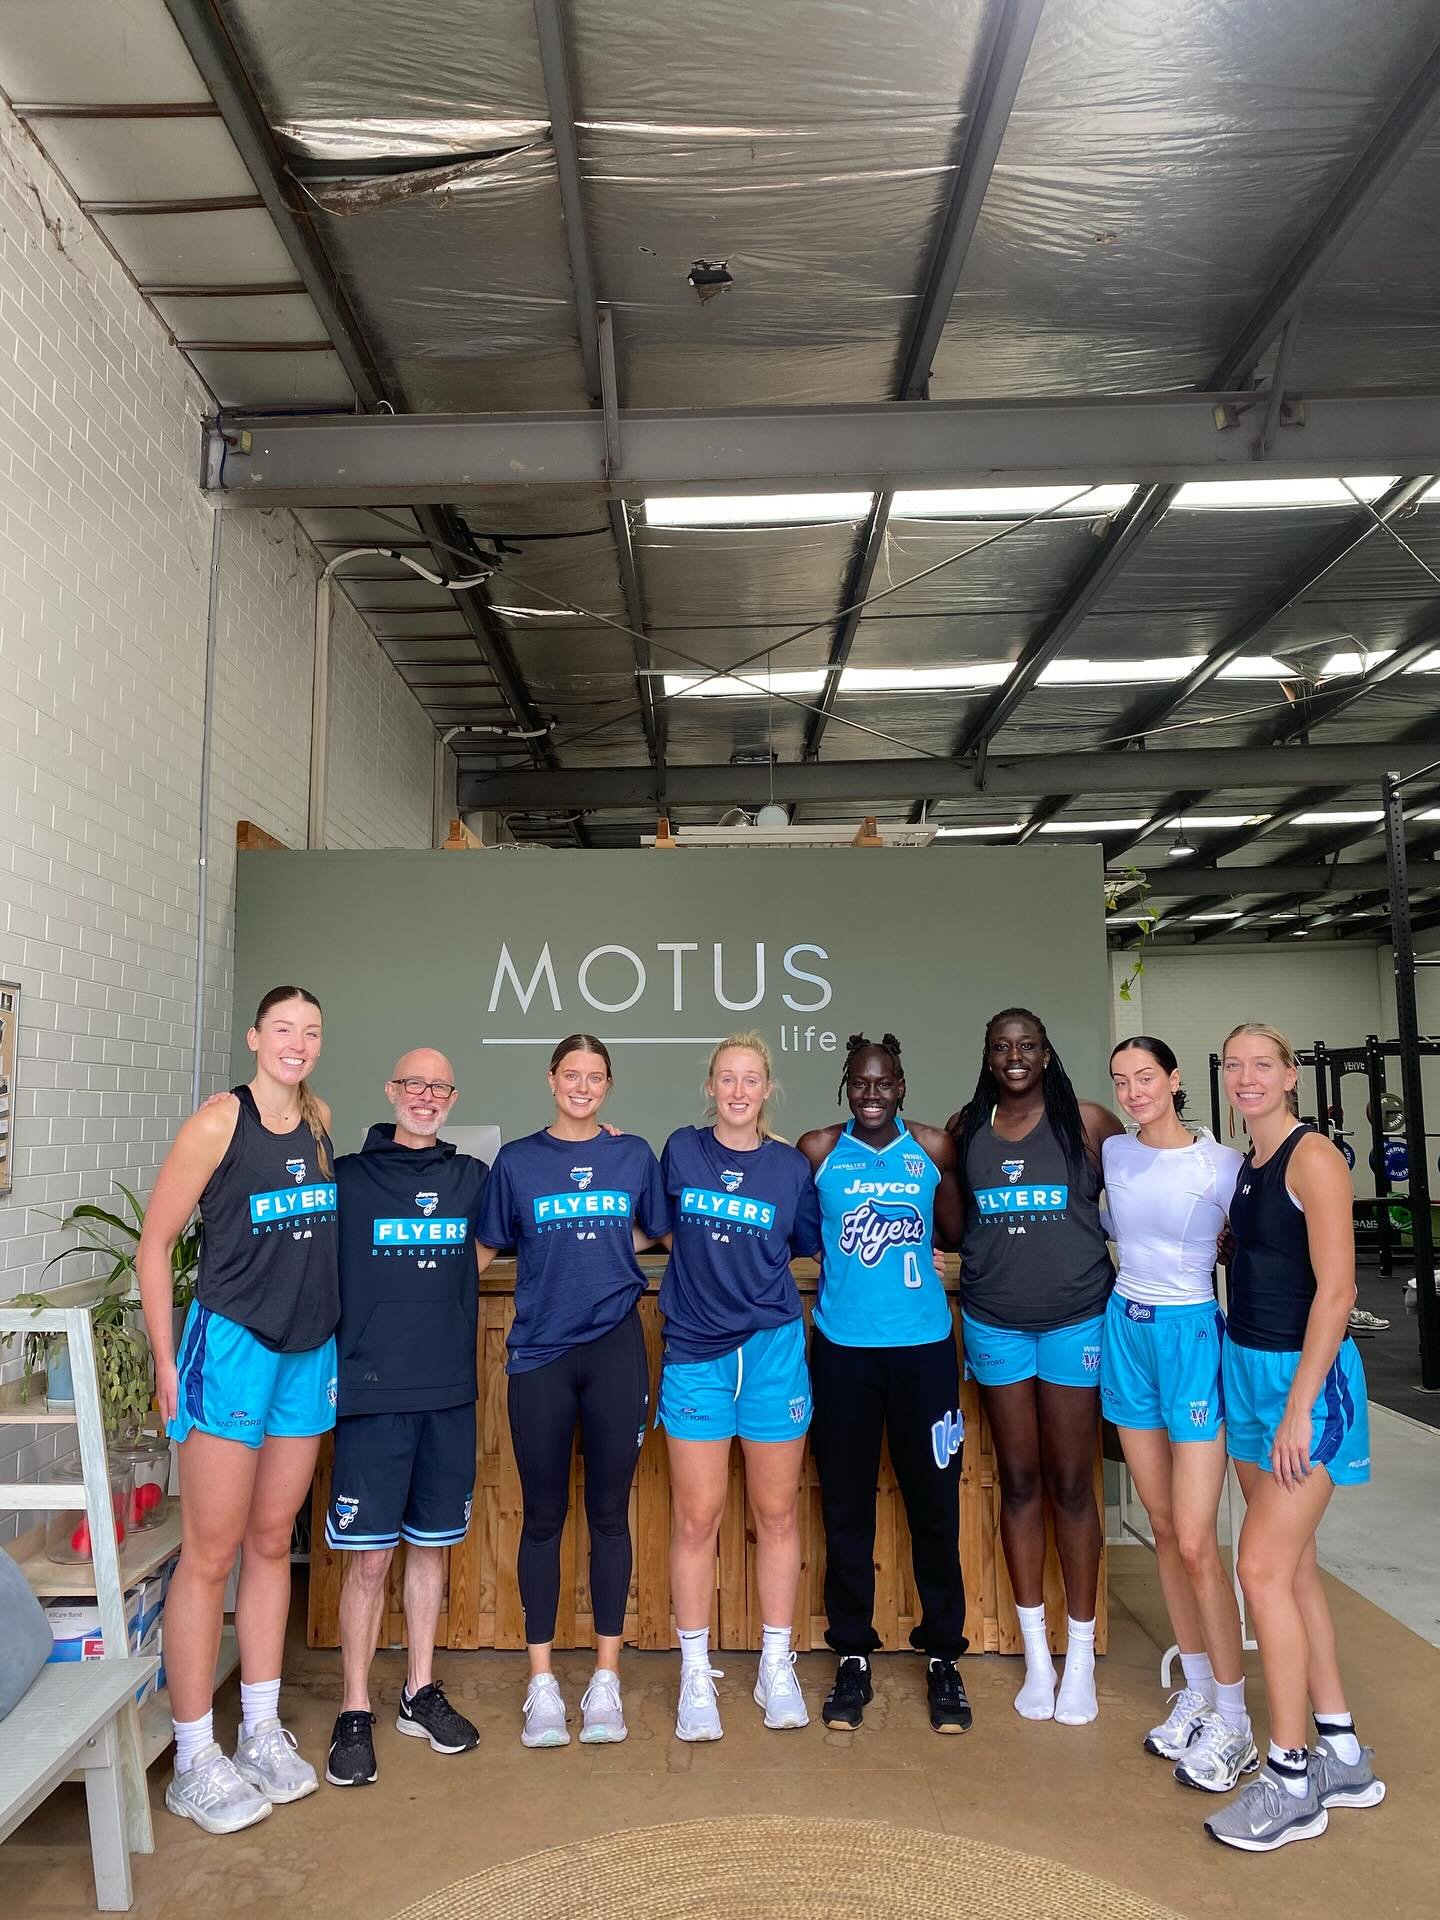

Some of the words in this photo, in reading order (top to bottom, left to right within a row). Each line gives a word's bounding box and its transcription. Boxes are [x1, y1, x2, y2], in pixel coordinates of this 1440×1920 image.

[487, 941, 833, 1014] MOTUS
[780, 1025, 837, 1052] life
[1343, 1061, 1365, 1071] VERVE
[1385, 1146, 1406, 1156] VERVE
[844, 1179, 921, 1197] Jayco
[256, 1188, 335, 1217] FLYERS
[538, 1195, 627, 1218] FLYERS
[684, 1192, 771, 1224] FLYERS
[977, 1190, 1062, 1210] FLYERS
[379, 1223, 466, 1240] FLYERS
[840, 1203, 924, 1265] Flyers
[372, 1247, 465, 1257] BASKETBALL
[904, 1251, 922, 1289] 0
